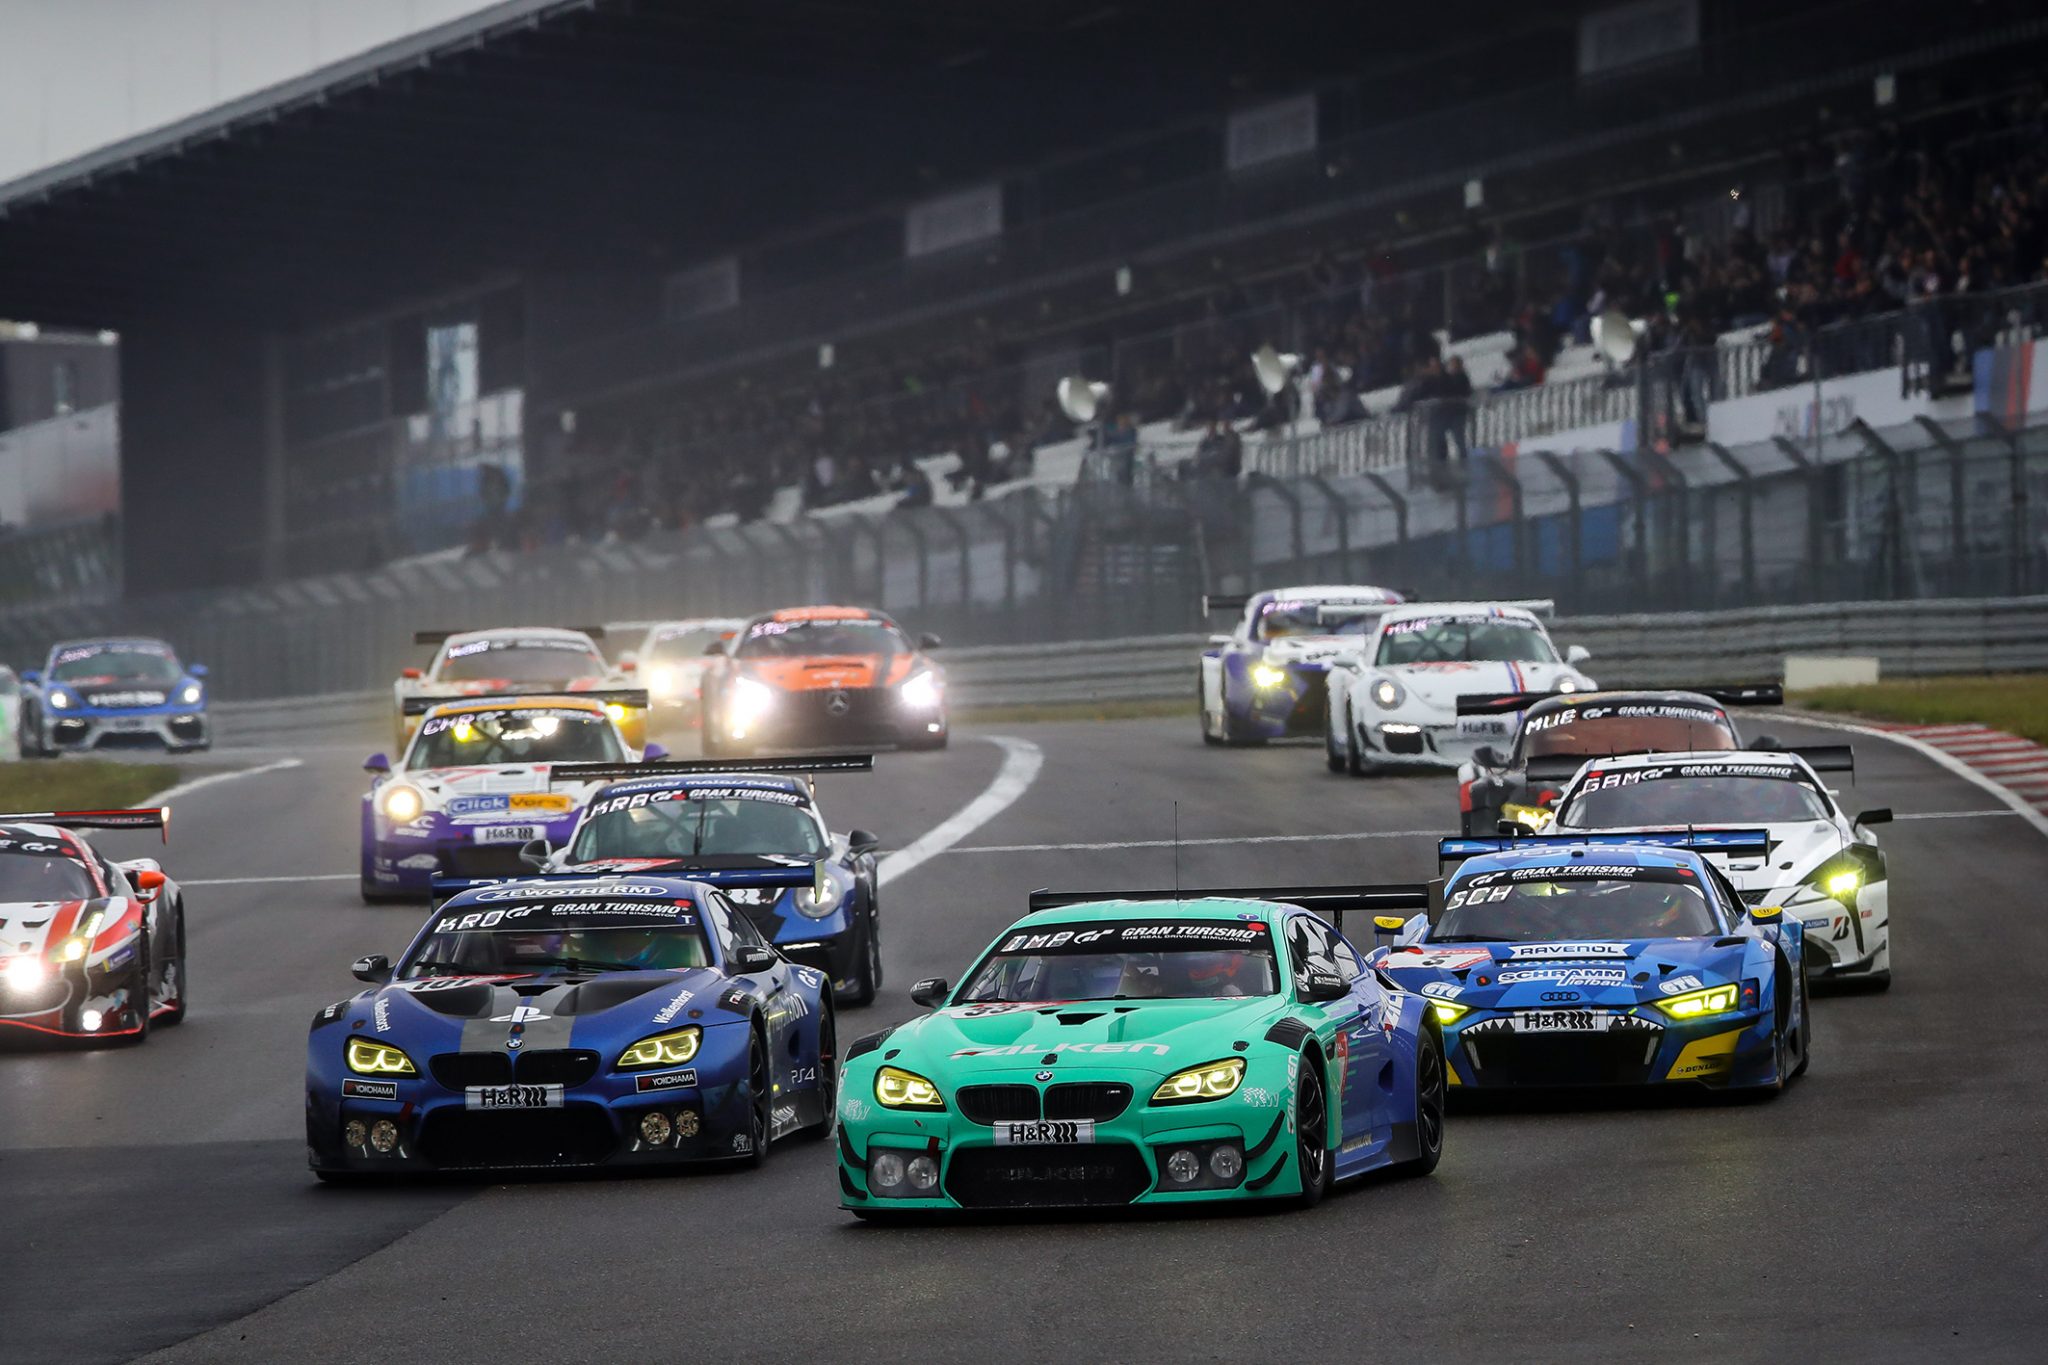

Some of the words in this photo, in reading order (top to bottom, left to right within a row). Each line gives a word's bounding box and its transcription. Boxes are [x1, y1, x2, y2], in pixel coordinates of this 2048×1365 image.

[1525, 708, 1577, 735] MUE
[1617, 706, 1656, 717] GRAN
[1581, 771, 1641, 793] GAM
[1680, 765, 1723, 775] GRAN
[1726, 765, 1791, 776] TURISMO
[688, 788, 731, 798] GRAN
[733, 788, 798, 802] TURISMO
[452, 797, 506, 812] Click
[1512, 867, 1559, 877] GRAN
[1563, 865, 1637, 874] TURISMO
[493, 885, 652, 899] ZEWOTHERM
[1446, 885, 1513, 911] SCH
[434, 910, 505, 934] KRO
[551, 902, 600, 913] GRAN
[604, 902, 681, 914] TURISMO
[1121, 927, 1171, 937] GRAN
[1175, 926, 1257, 938] TURISMO
[1201, 935, 1252, 943] SIMULATOR
[1520, 944, 1618, 955] RAVENOL
[1500, 969, 1624, 982] SCHRAMM
[652, 989, 695, 1025] Walkenhorst
[1523, 1011, 1569, 1030] H&R
[948, 1043, 1171, 1060] FALKEN
[652, 1073, 695, 1086] YOKOHAMA
[791, 1067, 816, 1085] PS4
[355, 1082, 394, 1095] YOKOHAMA
[1286, 1054, 1298, 1134] FALKEN
[480, 1088, 520, 1107] H&R
[1009, 1123, 1050, 1142] H&R
